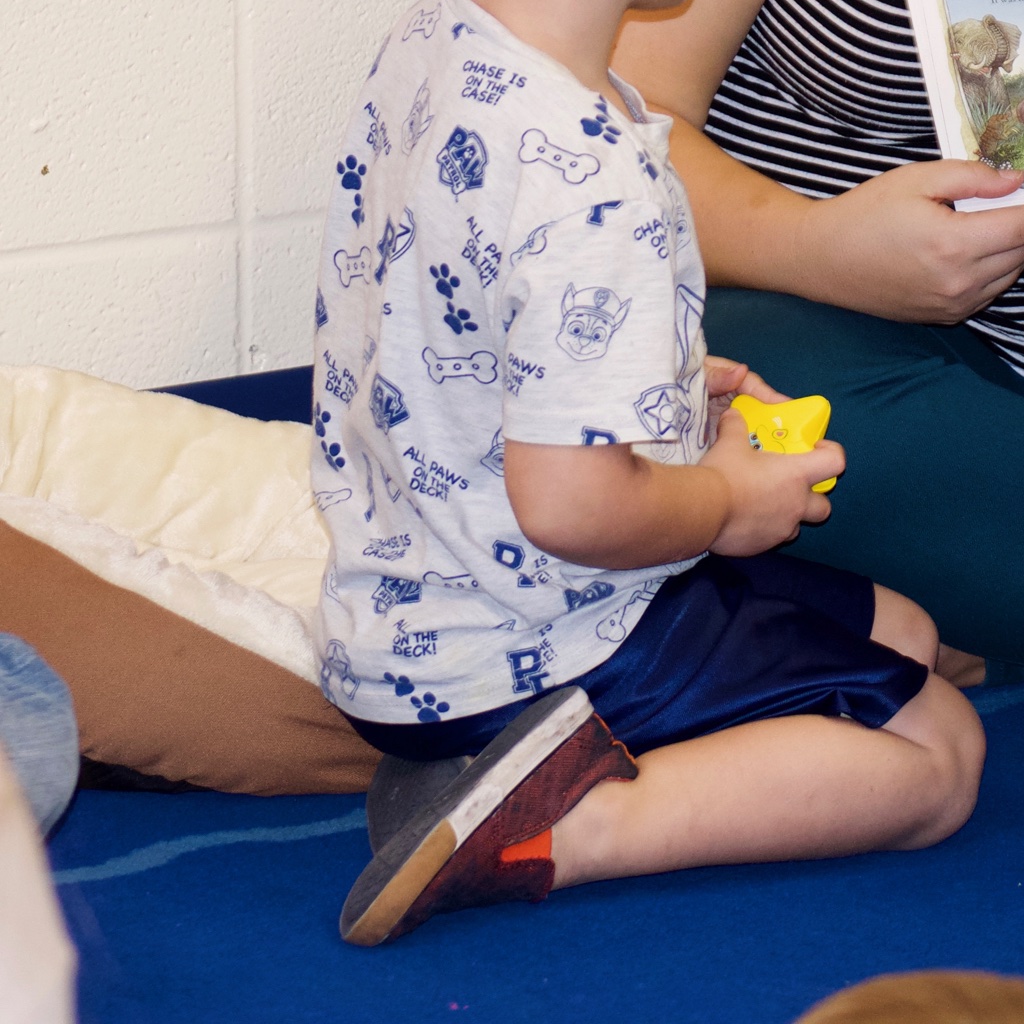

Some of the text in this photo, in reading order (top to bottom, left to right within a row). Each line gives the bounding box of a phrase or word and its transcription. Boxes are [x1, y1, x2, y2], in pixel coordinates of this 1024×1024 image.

[463, 60, 527, 88] CHASE IS
[466, 75, 508, 94] ON THE
[461, 86, 501, 106] CASE!
[441, 155, 461, 189] PATROL
[466, 216, 483, 244] ALL
[323, 349, 338, 372] ALL
[508, 353, 546, 379] PAWS
[327, 370, 342, 385] ON
[403, 446, 470, 490] ALL PAWS
[413, 466, 451, 493] ON THE
[409, 477, 448, 502] DECK!
[534, 555, 548, 568] IS
[393, 630, 438, 646] ON THE
[393, 642, 437, 657] DECK!
